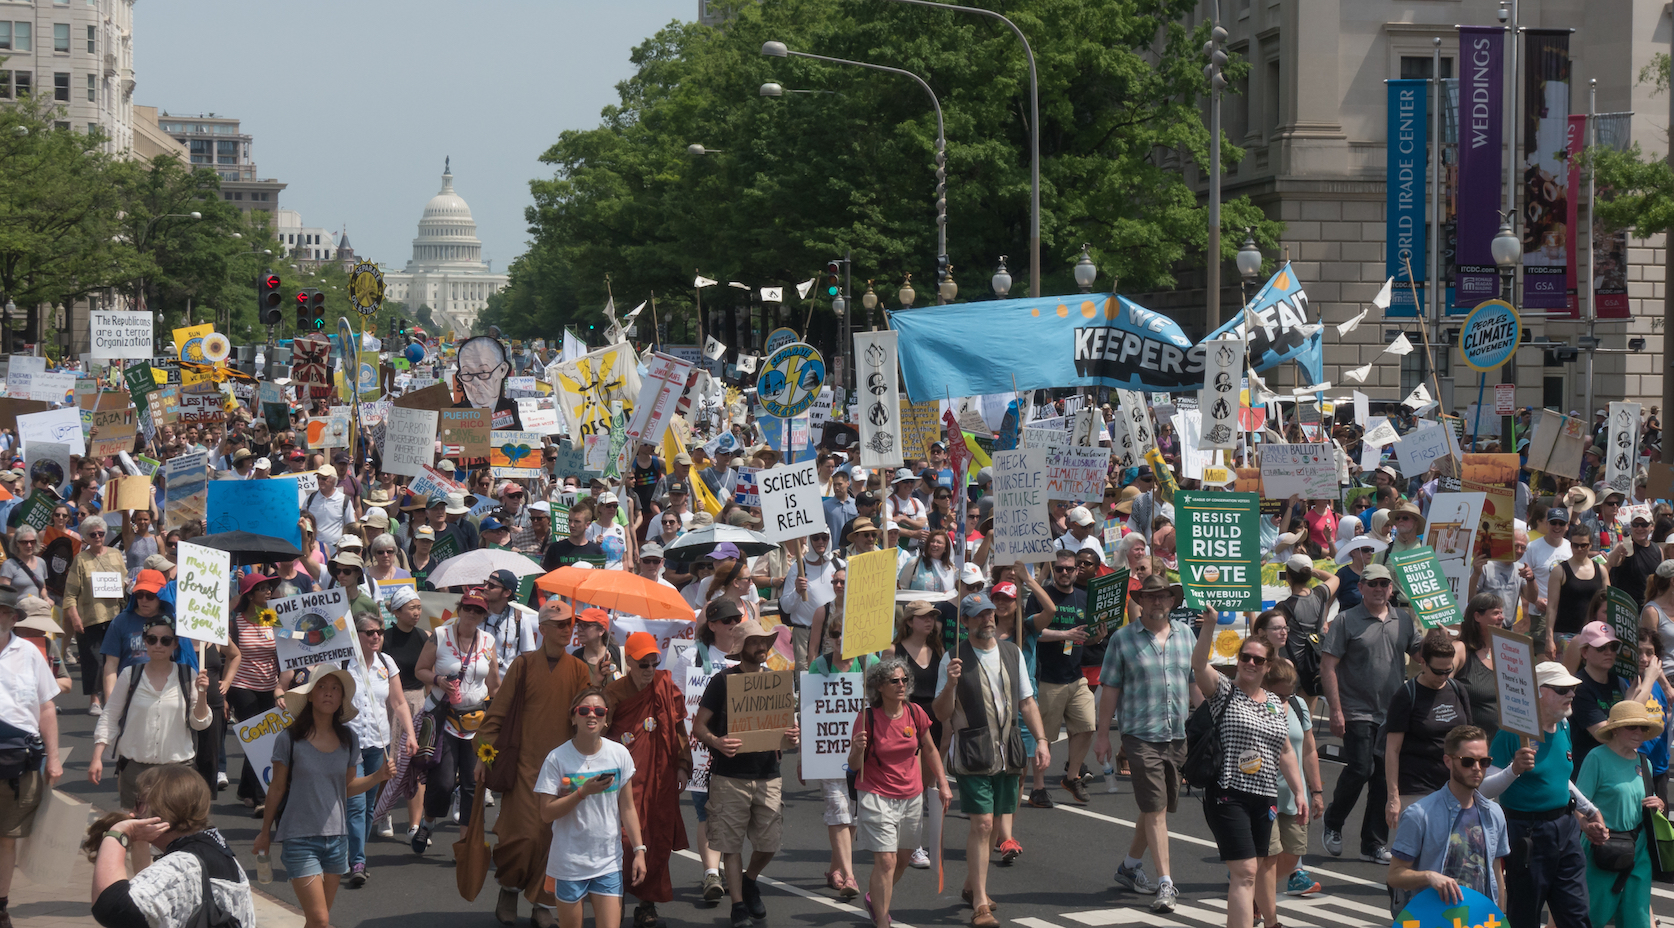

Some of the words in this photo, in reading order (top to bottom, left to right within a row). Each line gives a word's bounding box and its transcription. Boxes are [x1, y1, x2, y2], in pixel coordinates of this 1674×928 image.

[1472, 38, 1491, 148] WEDDINGS
[1399, 90, 1415, 154] CENTER
[1399, 158, 1414, 210] TRADE
[1398, 215, 1413, 277] WORLD
[1535, 282, 1554, 290] GSA
[95, 315, 111, 326] The
[112, 316, 151, 327] Republicans
[1129, 304, 1173, 333] WE
[96, 329, 113, 338] are
[116, 329, 122, 338] a
[125, 326, 150, 338] terror
[1464, 321, 1516, 350] CLIMATE
[96, 336, 151, 350] Organization
[1074, 326, 1207, 374] KEEPERS
[1468, 338, 1515, 358] MOVEMENT
[770, 347, 814, 368] SEPARATE
[149, 393, 158, 401] no
[180, 397, 200, 407] LESS
[202, 396, 223, 407] MEAT
[767, 401, 783, 415] OIL
[788, 392, 816, 415] STATE
[151, 401, 160, 409] no
[96, 412, 121, 427] GAZA
[153, 409, 162, 417] no
[179, 412, 199, 422] LESS
[200, 411, 223, 422] HEAT
[391, 407, 412, 419] KEEP
[418, 410, 433, 421] THE
[444, 411, 481, 420] PUERTO
[155, 417, 164, 426] no
[397, 421, 430, 435] CARBON
[460, 420, 485, 429] RICO
[387, 434, 431, 446] UNDERGROUND
[451, 429, 474, 437] SAVE
[908, 433, 926, 441] going
[1411, 431, 1438, 446] EARTH
[99, 442, 127, 455] RIGHT
[395, 444, 414, 456] WHERE
[416, 446, 425, 456] IT
[1290, 444, 1319, 456] BALLOT
[1410, 442, 1447, 463] FIRST!
[996, 453, 1027, 472] CHECK
[1046, 456, 1061, 466] FROM
[1098, 459, 1107, 468] CA
[1261, 454, 1289, 464] SENSE
[994, 471, 1042, 492] YOURSELF.
[1081, 468, 1105, 481] CHANGE
[1047, 479, 1084, 493] MATTERS
[1084, 480, 1090, 494] 2
[998, 490, 1041, 507] NATURE
[777, 510, 813, 532] REAL
[995, 510, 1008, 524] HAS
[1016, 508, 1028, 523] ITS
[1192, 512, 1241, 524] RESIST
[994, 524, 1007, 538] OWN
[1009, 521, 1049, 538] CHECKS
[1192, 525, 1242, 539] BUILD
[994, 540, 1007, 555] AND
[1009, 537, 1054, 555] BALANCES
[1192, 539, 1242, 558] RISE
[209, 561, 222, 580] the
[850, 551, 889, 576] FIXING
[1402, 560, 1431, 574] RESIST
[1190, 564, 1247, 583] VOTE
[1406, 569, 1435, 584] BUILD
[97, 576, 118, 587] unpaid
[847, 569, 889, 596] CLIMATE
[1098, 581, 1123, 594] RESIST
[1409, 578, 1441, 596] RISE
[94, 586, 123, 597] protester
[1096, 589, 1122, 602] BUILD
[1190, 589, 1205, 599] Text
[1206, 590, 1251, 599] WEBUILD
[275, 599, 299, 615] ONE
[301, 591, 341, 608] WORLD
[846, 589, 887, 615] CHANGE
[1095, 595, 1121, 611] RISE
[1198, 599, 1205, 607] to
[1206, 599, 1242, 608] 877-877
[1415, 594, 1450, 611] VOTE
[200, 602, 221, 622] with
[311, 607, 334, 624] PROTECT
[845, 606, 890, 633] CREATES
[1093, 606, 1121, 623] VOTE
[191, 614, 214, 631] you
[1615, 623, 1638, 647] RISE
[297, 642, 314, 652] HEAL
[844, 628, 877, 660] JOBS
[1501, 642, 1520, 655] Climate
[284, 646, 356, 670] INTERDEPENDENT
[1500, 652, 1518, 665] Change
[823, 677, 853, 696] IT'S
[1501, 672, 1518, 684] There's
[1519, 677, 1527, 687] No
[1505, 683, 1521, 695] Planet
[1511, 696, 1522, 705] care
[1522, 699, 1530, 707] for
[731, 716, 754, 733] NOT
[757, 713, 789, 731] WALLS
[816, 721, 849, 737] NOT
